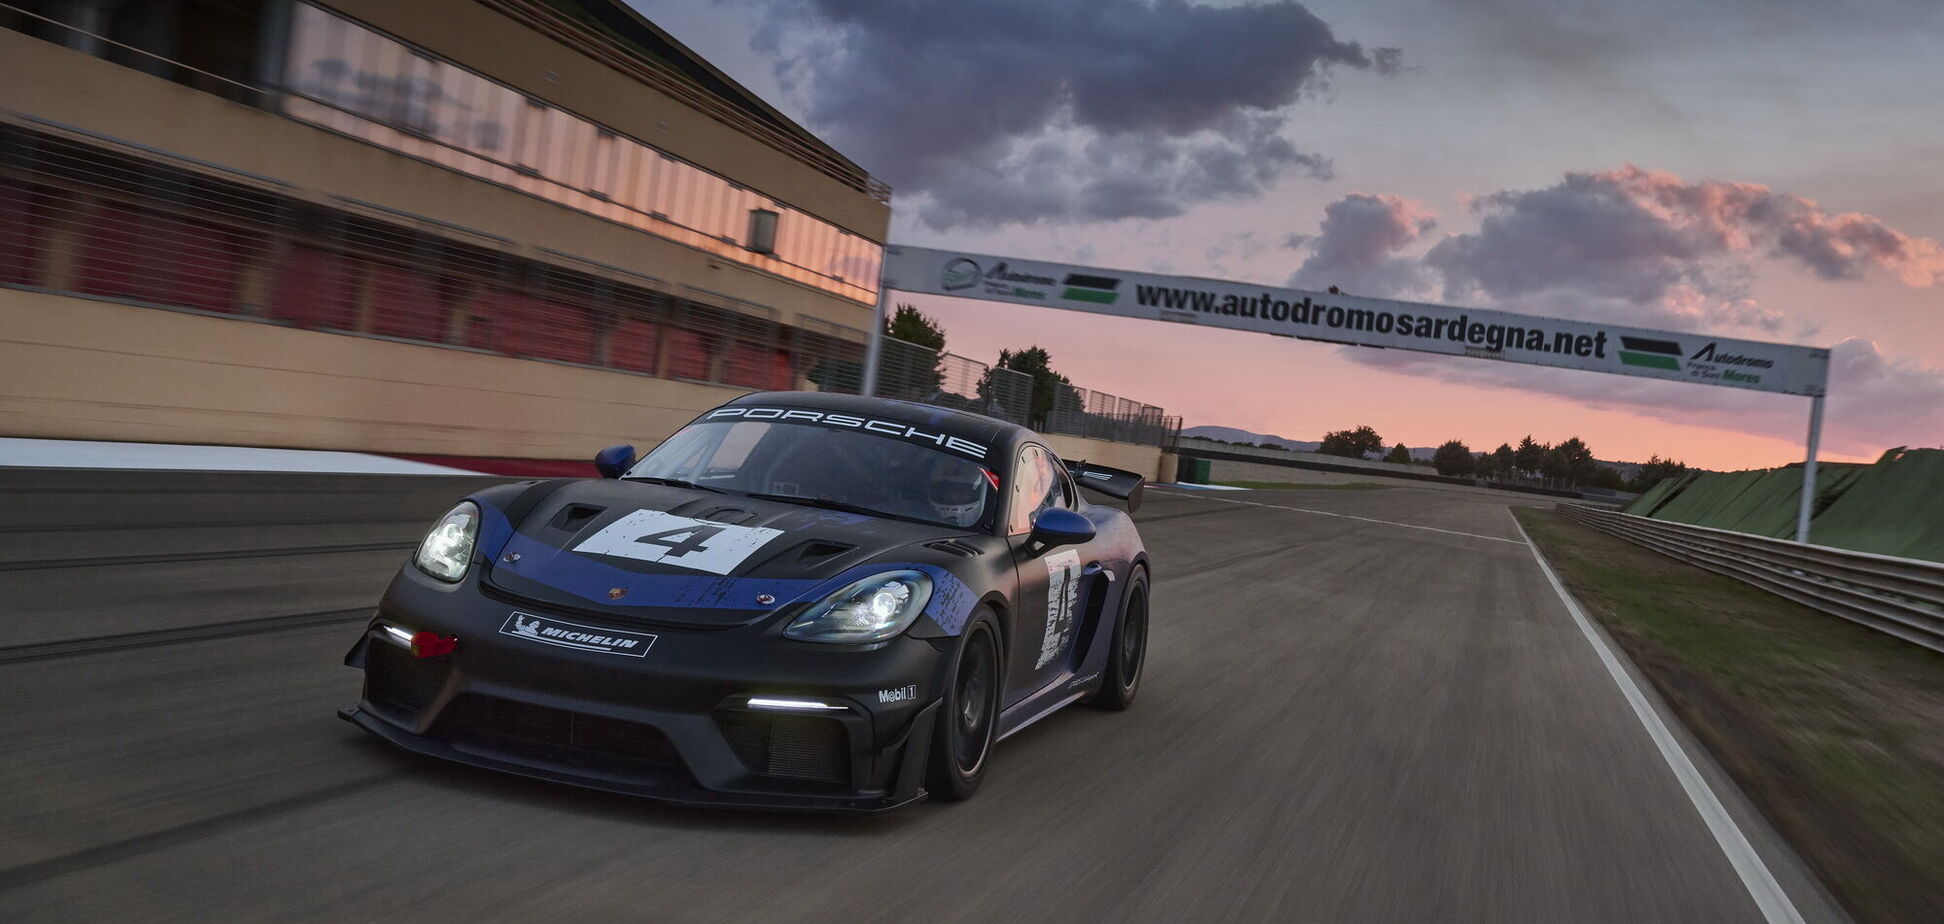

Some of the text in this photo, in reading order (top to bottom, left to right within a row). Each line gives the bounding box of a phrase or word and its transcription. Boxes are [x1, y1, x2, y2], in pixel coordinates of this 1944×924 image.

[1136, 283, 1607, 359] www.autodromosardegna.net
[1691, 342, 1774, 369] Autodromo
[707, 408, 988, 459] PORSCHE
[632, 524, 727, 558] 4
[541, 626, 640, 649] MICHELIN
[878, 686, 907, 703] Mobil
